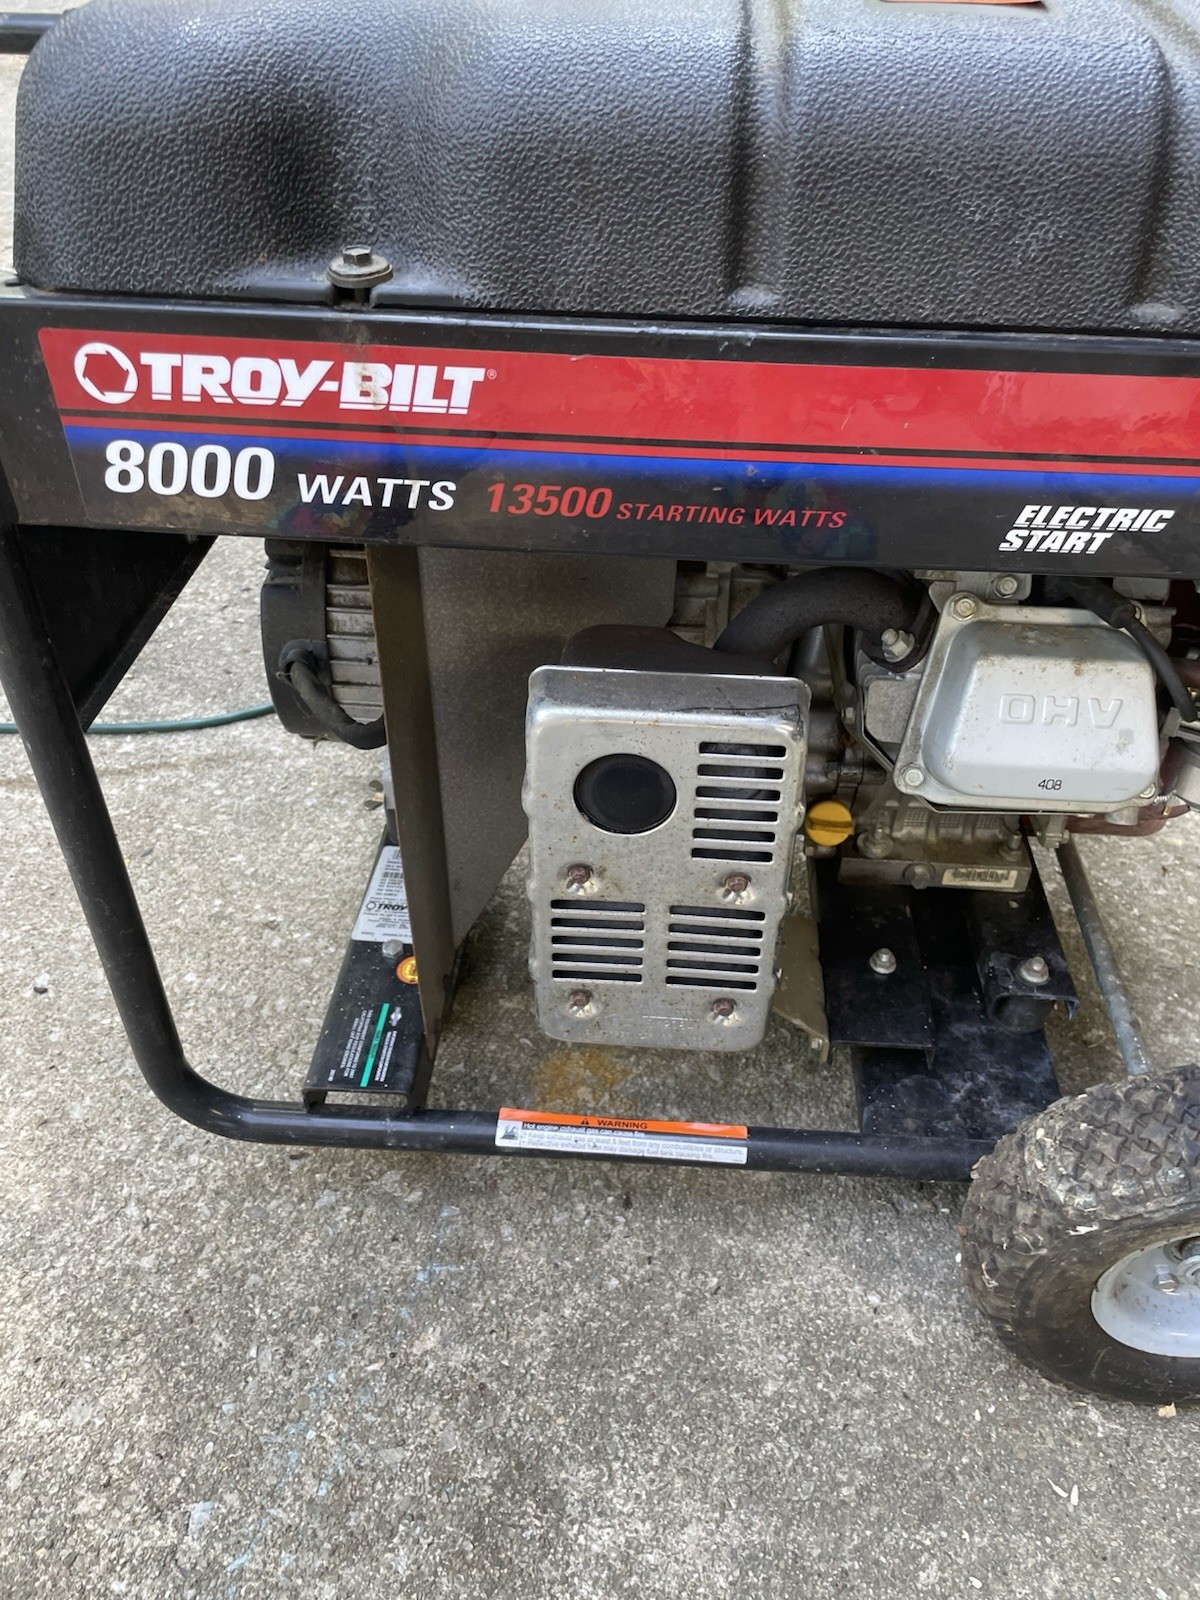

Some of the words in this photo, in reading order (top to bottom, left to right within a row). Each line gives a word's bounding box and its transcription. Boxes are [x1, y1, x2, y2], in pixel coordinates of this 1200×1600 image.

[140, 352, 486, 414] TROY-BILT
[104, 439, 275, 500] 8000
[297, 473, 458, 510] WATTS
[486, 482, 613, 519] 13500
[616, 503, 746, 525] STARTING
[754, 508, 848, 529] WATTS
[1013, 505, 1175, 533] ELECTRIC
[999, 530, 1113, 554] START
[999, 693, 1123, 729] OHV
[1038, 779, 1062, 790] 408
[598, 1119, 648, 1130] WARNING
